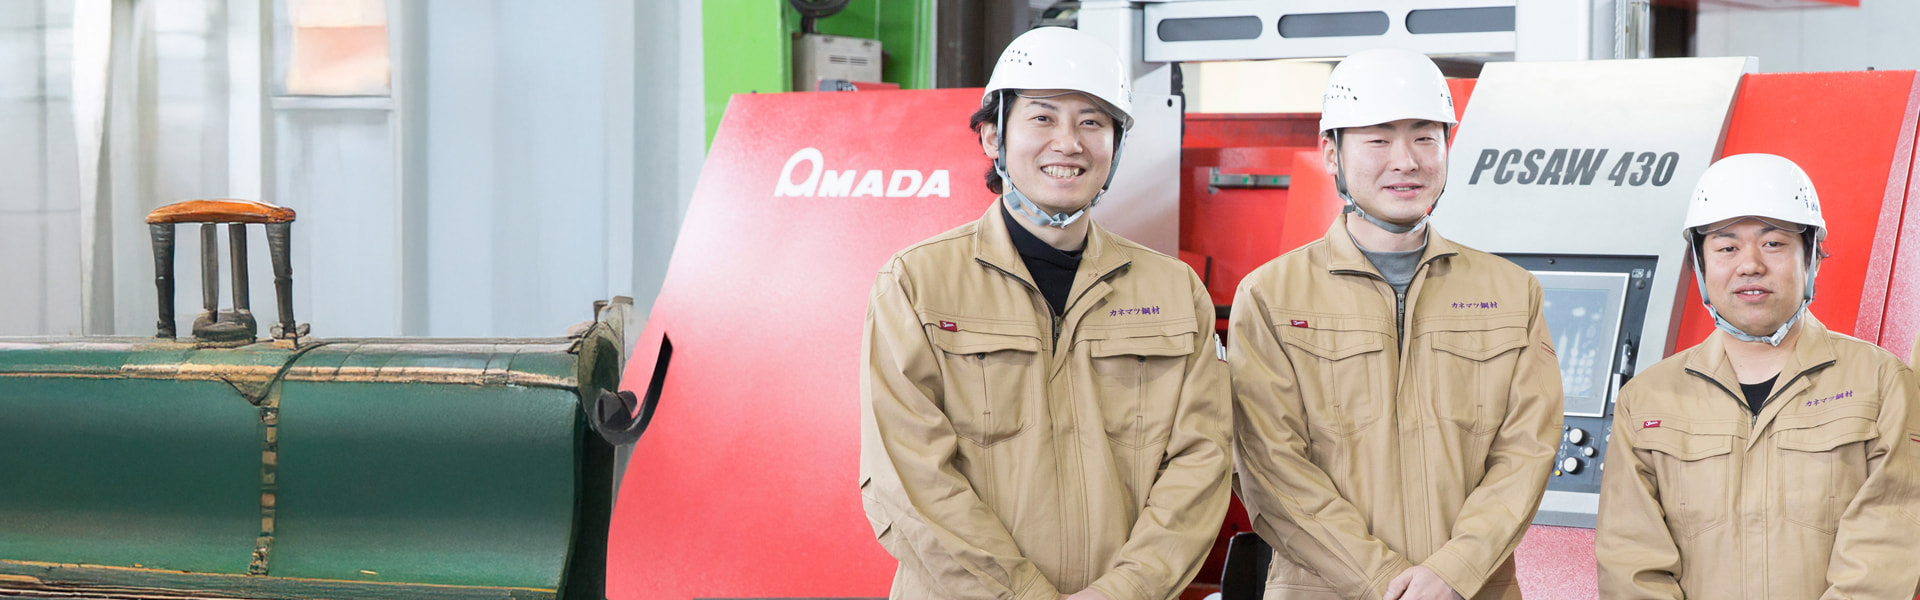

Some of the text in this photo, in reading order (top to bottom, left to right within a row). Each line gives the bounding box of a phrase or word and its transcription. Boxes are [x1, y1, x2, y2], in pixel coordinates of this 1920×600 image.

[774, 147, 951, 198] AMADA
[1468, 148, 1680, 187] PCSAW 430
